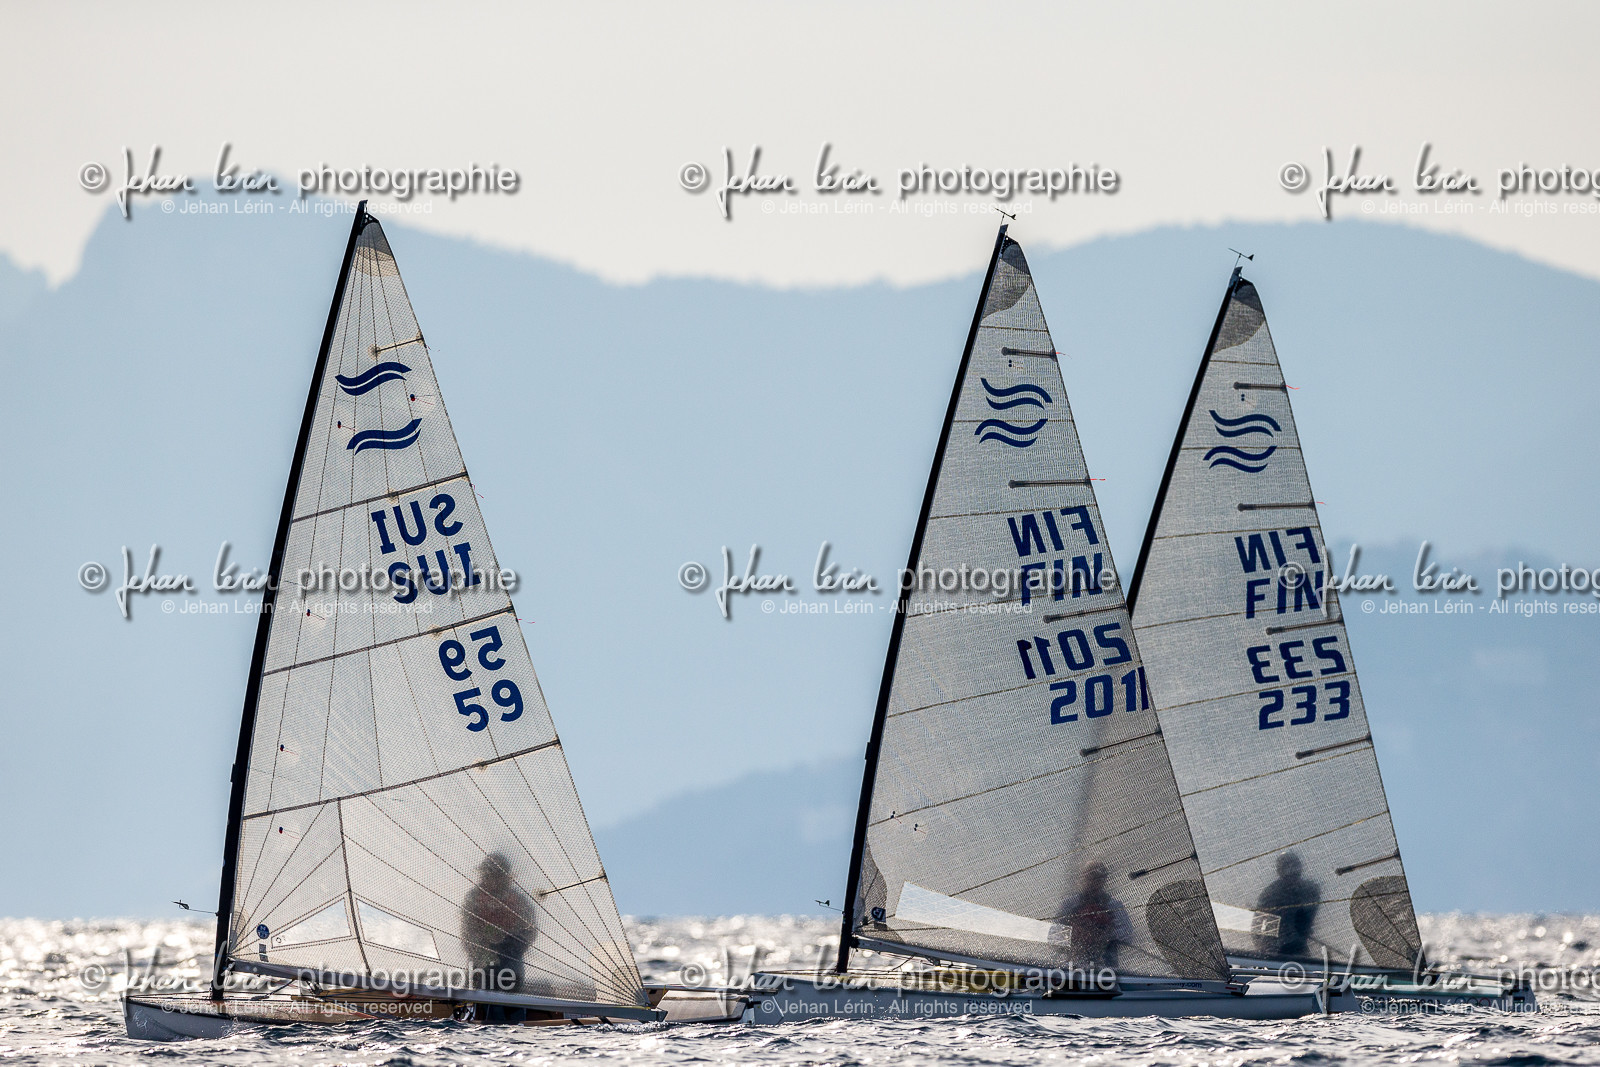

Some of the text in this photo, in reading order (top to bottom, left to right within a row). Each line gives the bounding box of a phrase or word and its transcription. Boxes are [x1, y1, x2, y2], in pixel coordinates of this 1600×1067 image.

[388, 542, 481, 604] SUI
[1021, 553, 1102, 607] FIN
[1246, 571, 1324, 619] FIN
[453, 679, 524, 732] 59
[1050, 666, 1149, 725] 2011
[1259, 680, 1350, 730] 233
